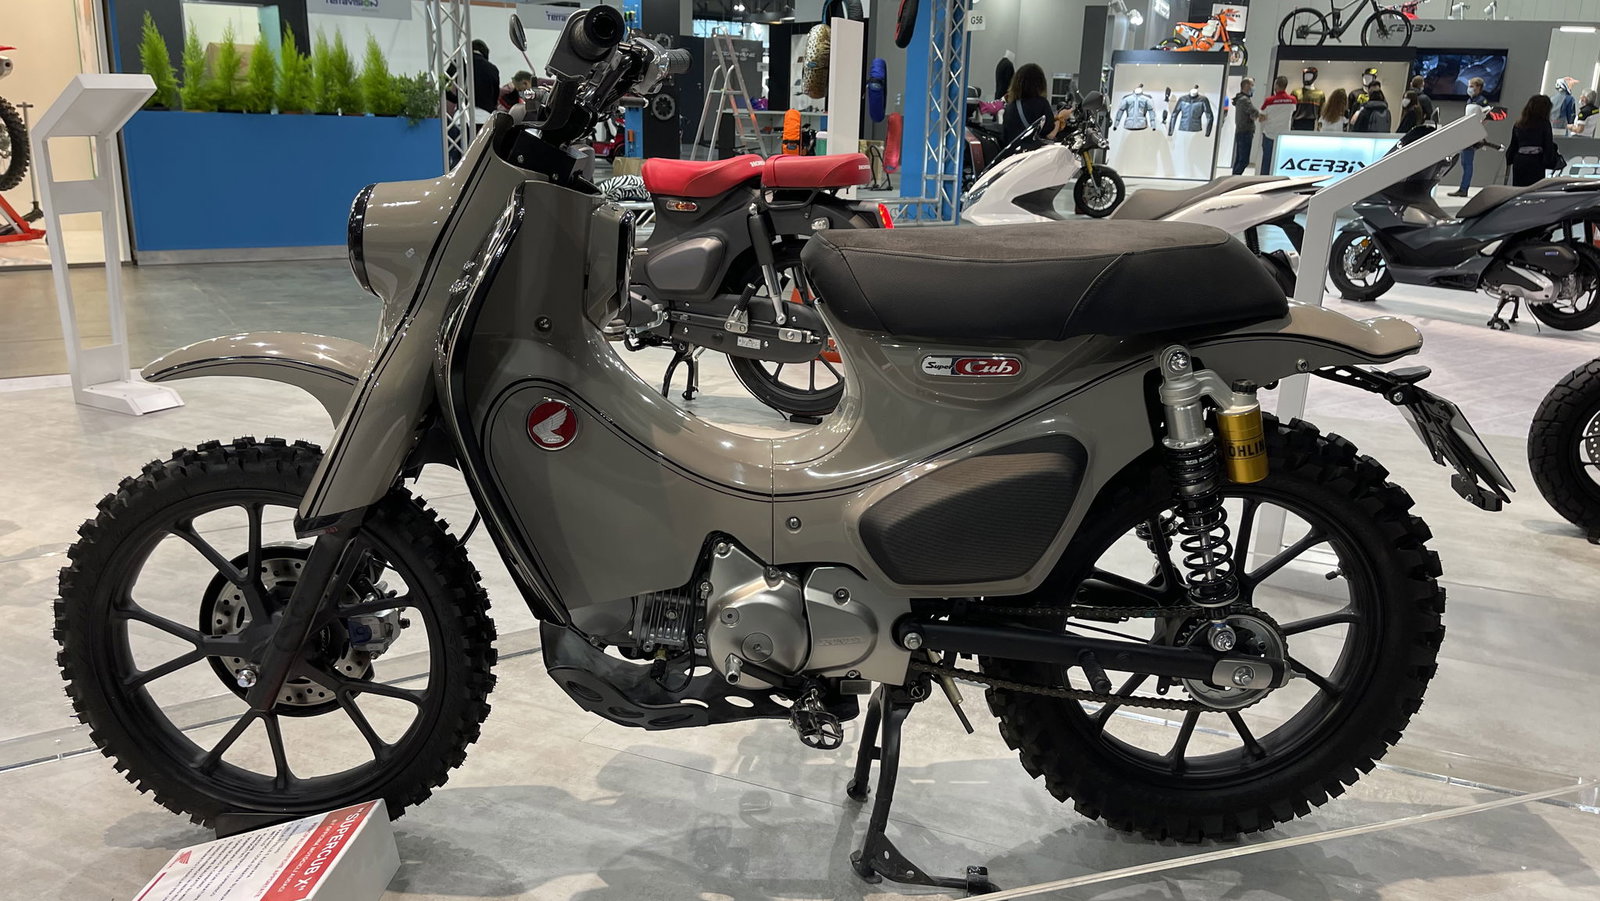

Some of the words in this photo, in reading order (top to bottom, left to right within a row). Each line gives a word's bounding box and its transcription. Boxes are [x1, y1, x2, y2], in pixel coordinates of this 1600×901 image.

[970, 16, 984, 25] G56
[925, 361, 955, 370] Super
[964, 360, 1013, 373] Cub
